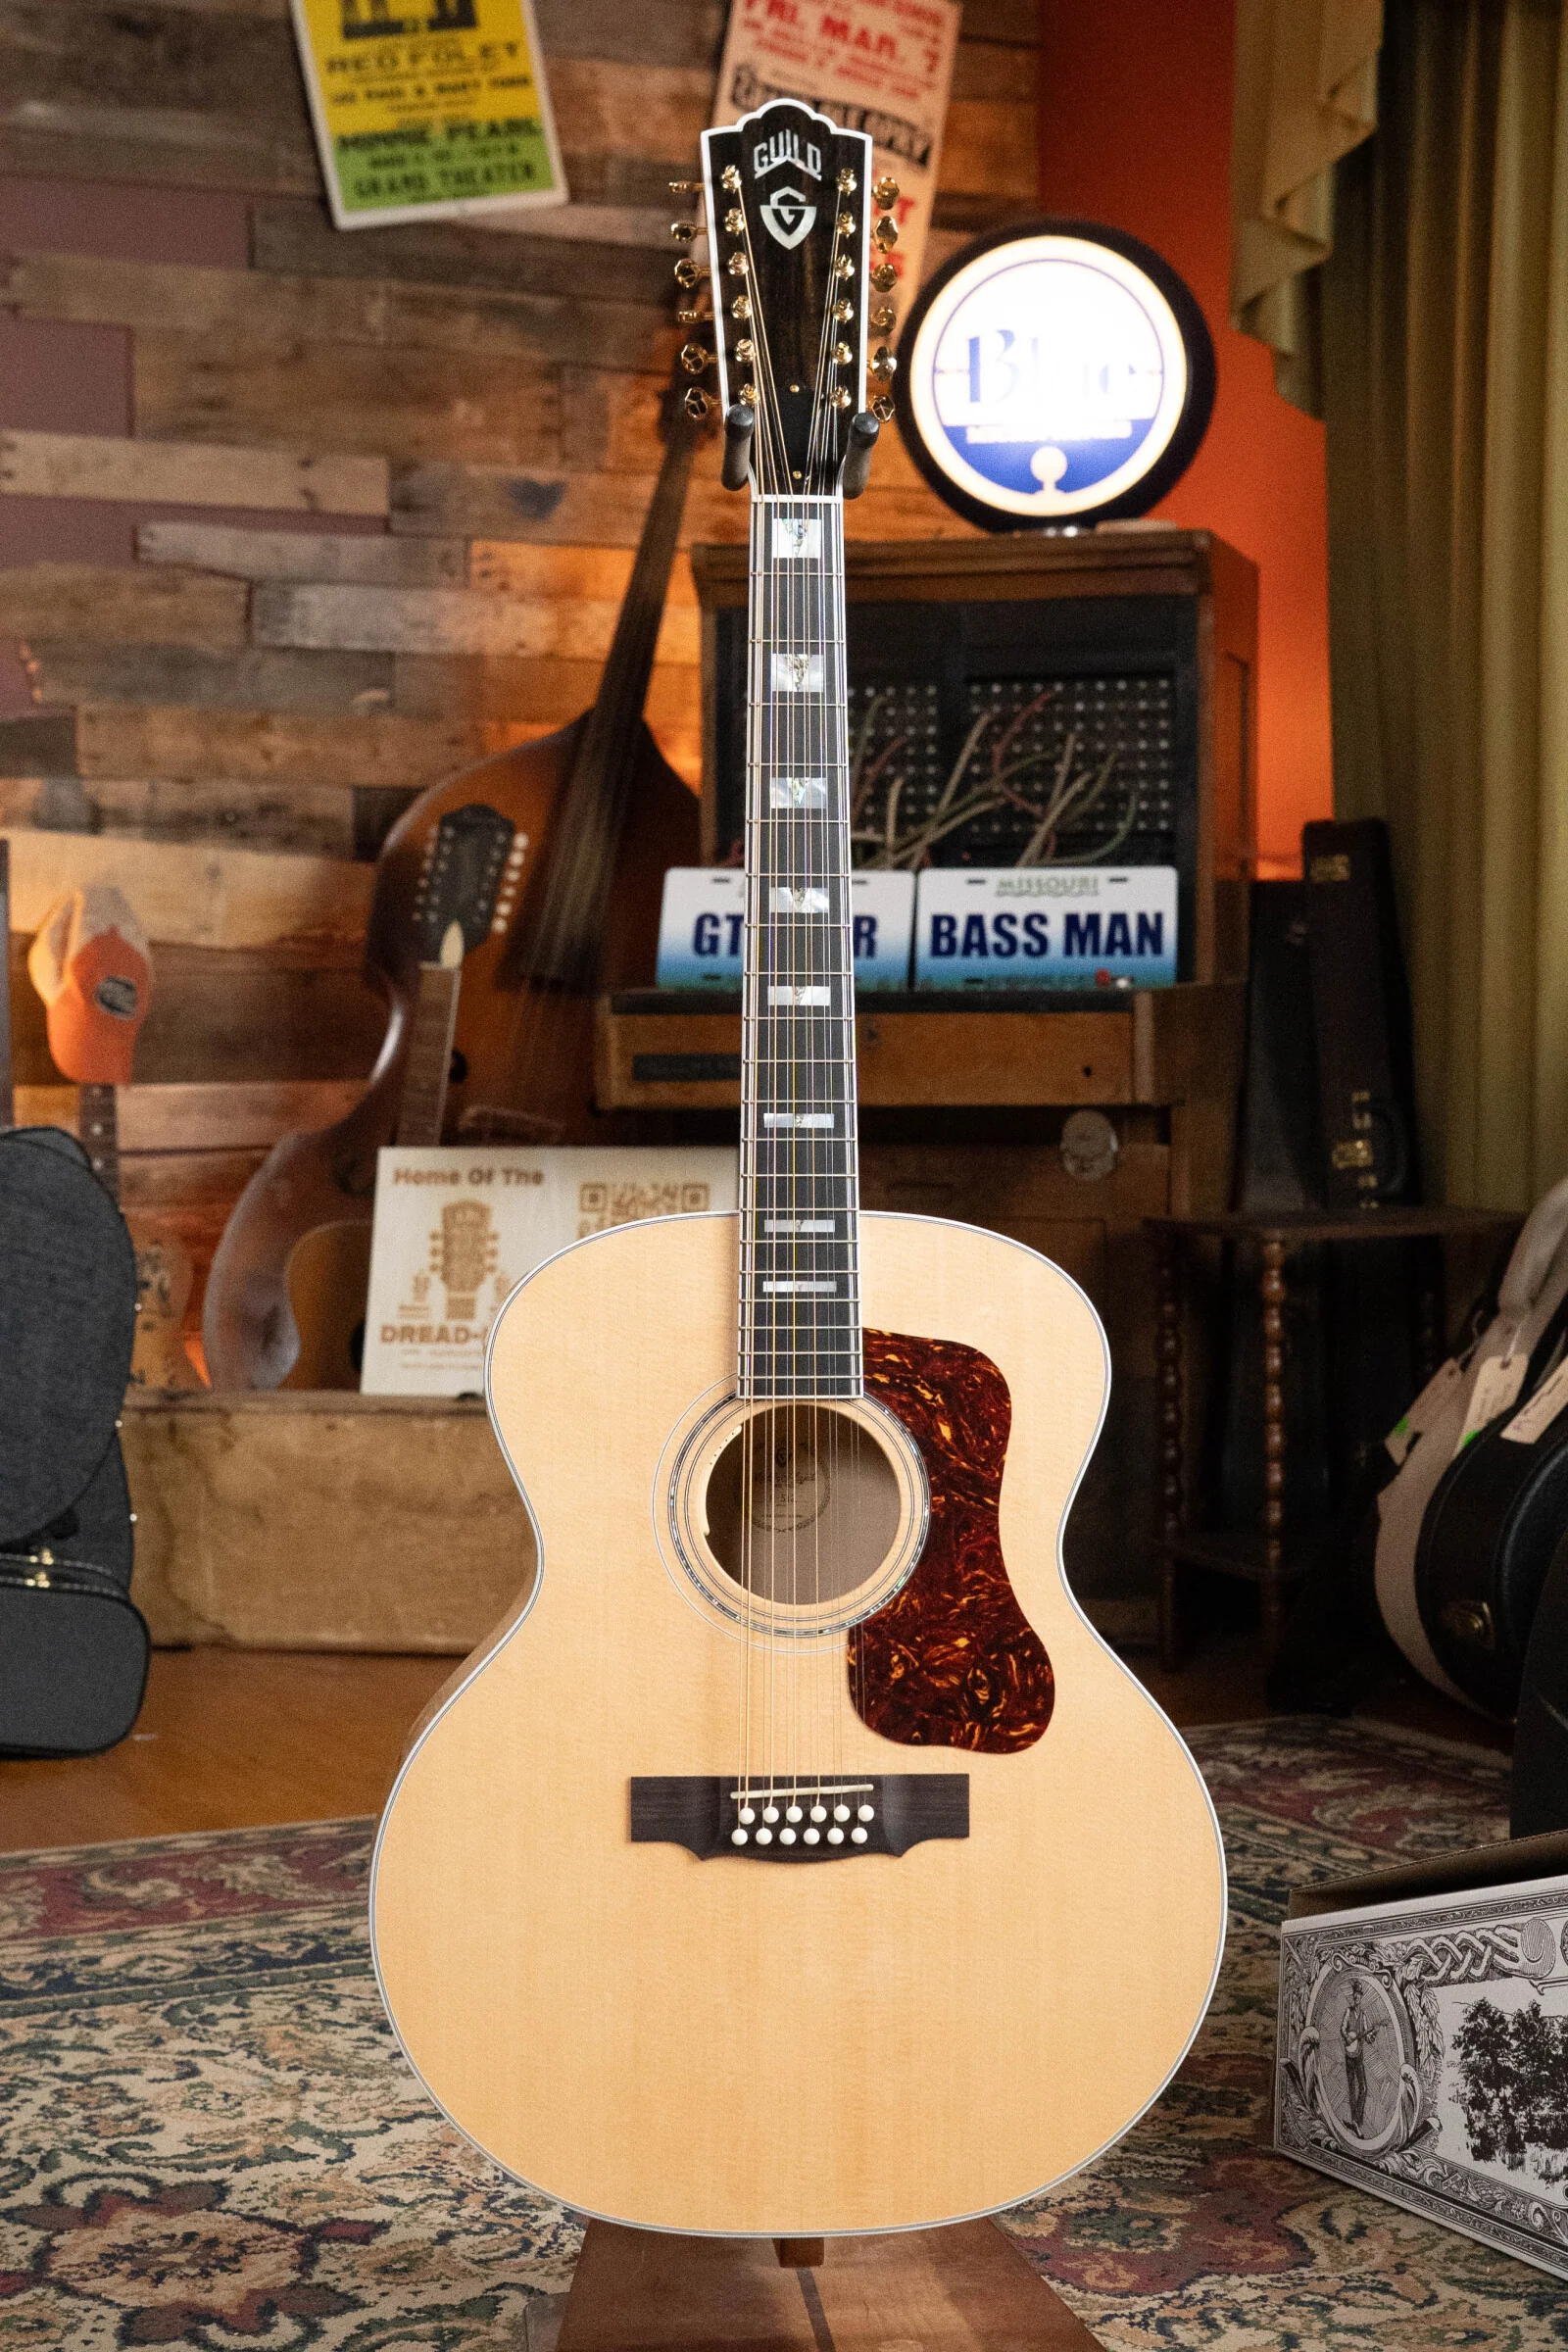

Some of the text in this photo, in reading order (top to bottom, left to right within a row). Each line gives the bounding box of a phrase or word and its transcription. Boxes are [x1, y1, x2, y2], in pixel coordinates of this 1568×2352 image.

[753, 128, 822, 181] GUILD
[996, 874, 1100, 898] MISSOURI
[931, 911, 1164, 957] BASS MAN
[394, 1167, 544, 1185] Home Of The
